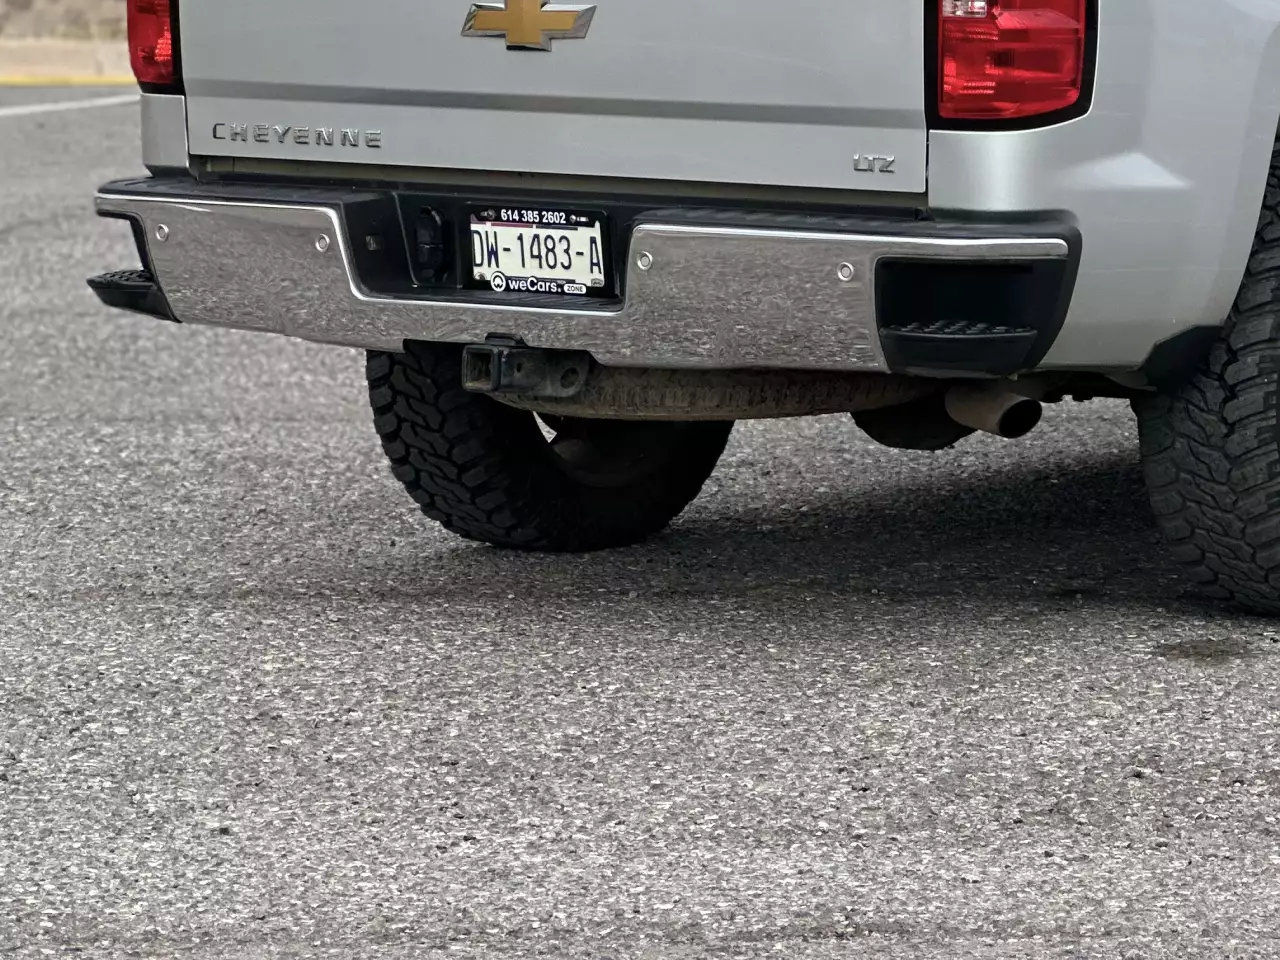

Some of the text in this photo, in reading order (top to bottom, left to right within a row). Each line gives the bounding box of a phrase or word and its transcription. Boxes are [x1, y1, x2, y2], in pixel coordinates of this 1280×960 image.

[212, 121, 383, 149] CHEYENNE
[852, 153, 896, 174] LTZ
[500, 208, 567, 224] 614 385 2602
[470, 229, 603, 275] DW-1483-A
[565, 284, 585, 294] ZONE
